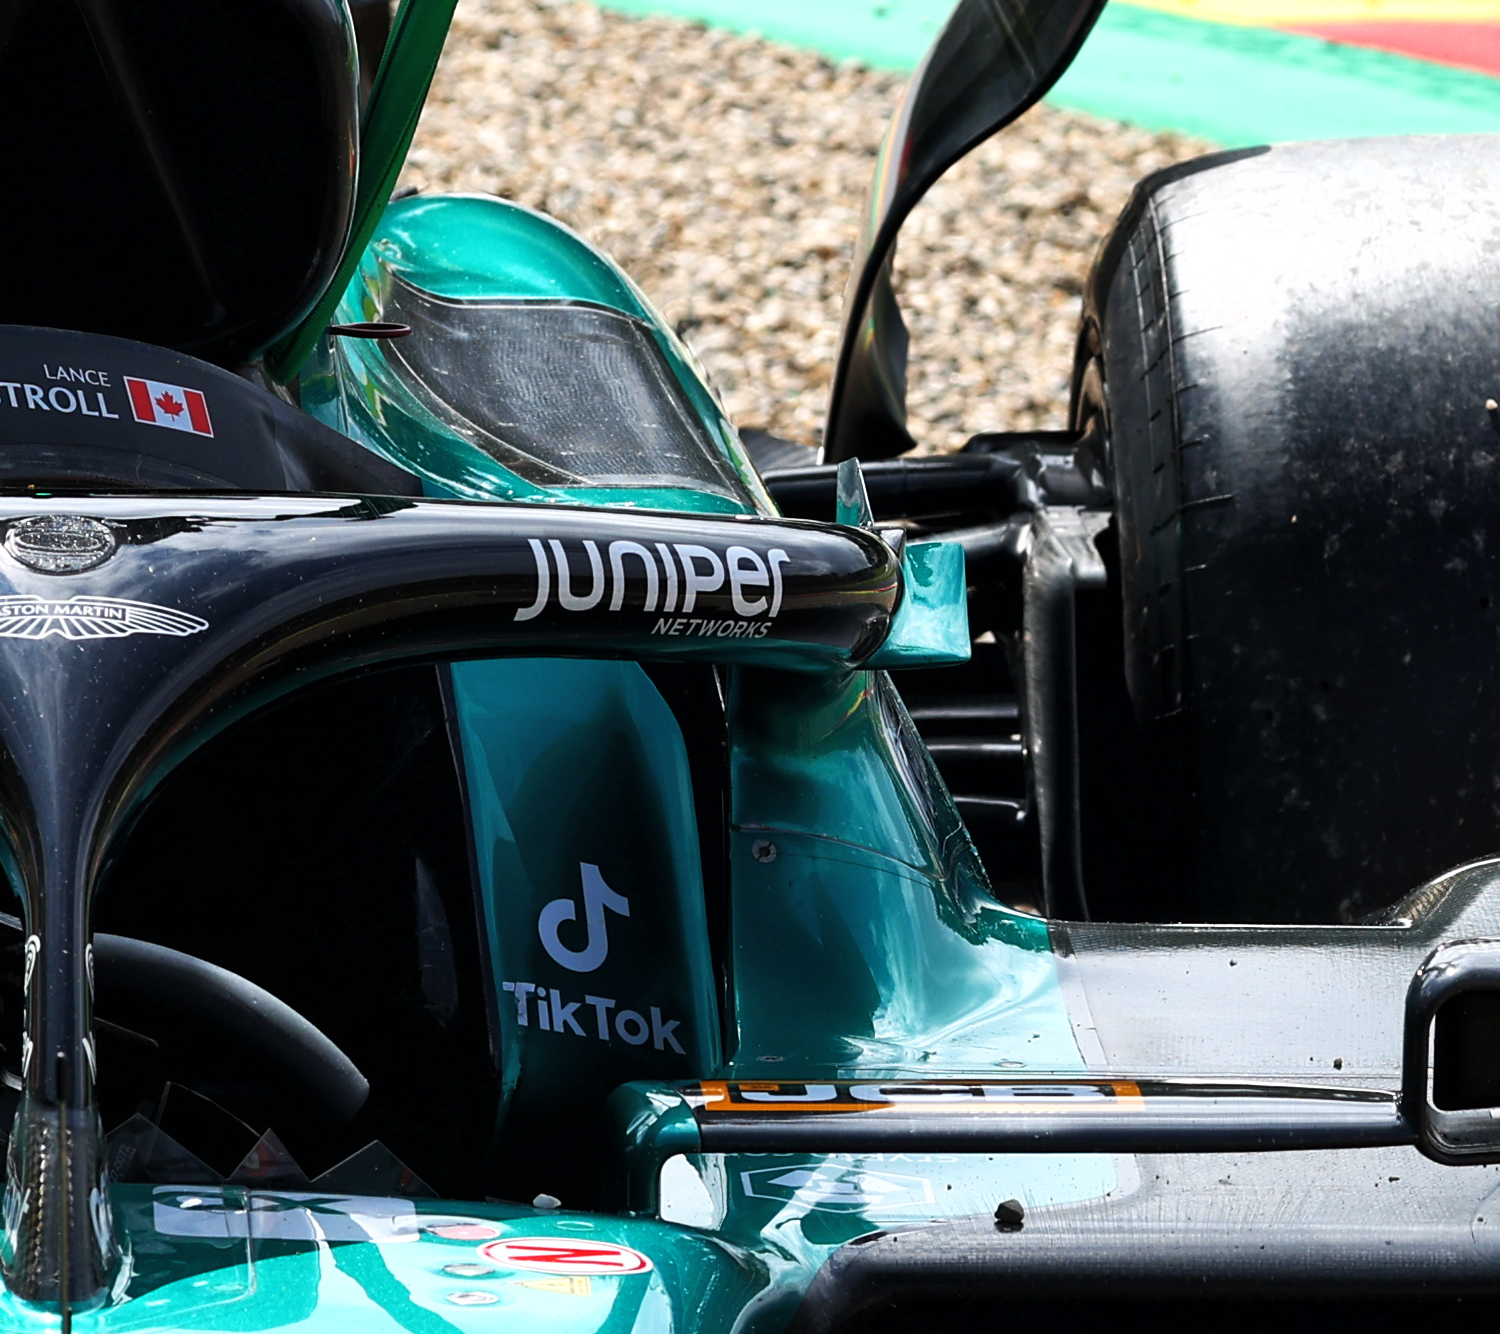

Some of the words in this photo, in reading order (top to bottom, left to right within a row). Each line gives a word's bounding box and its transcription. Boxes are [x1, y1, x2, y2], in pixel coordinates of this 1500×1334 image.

[43, 362, 112, 389] LANCE
[53, 604, 124, 620] MARTIN
[650, 617, 773, 640] NETWORKS
[501, 981, 687, 1056] TikTok
